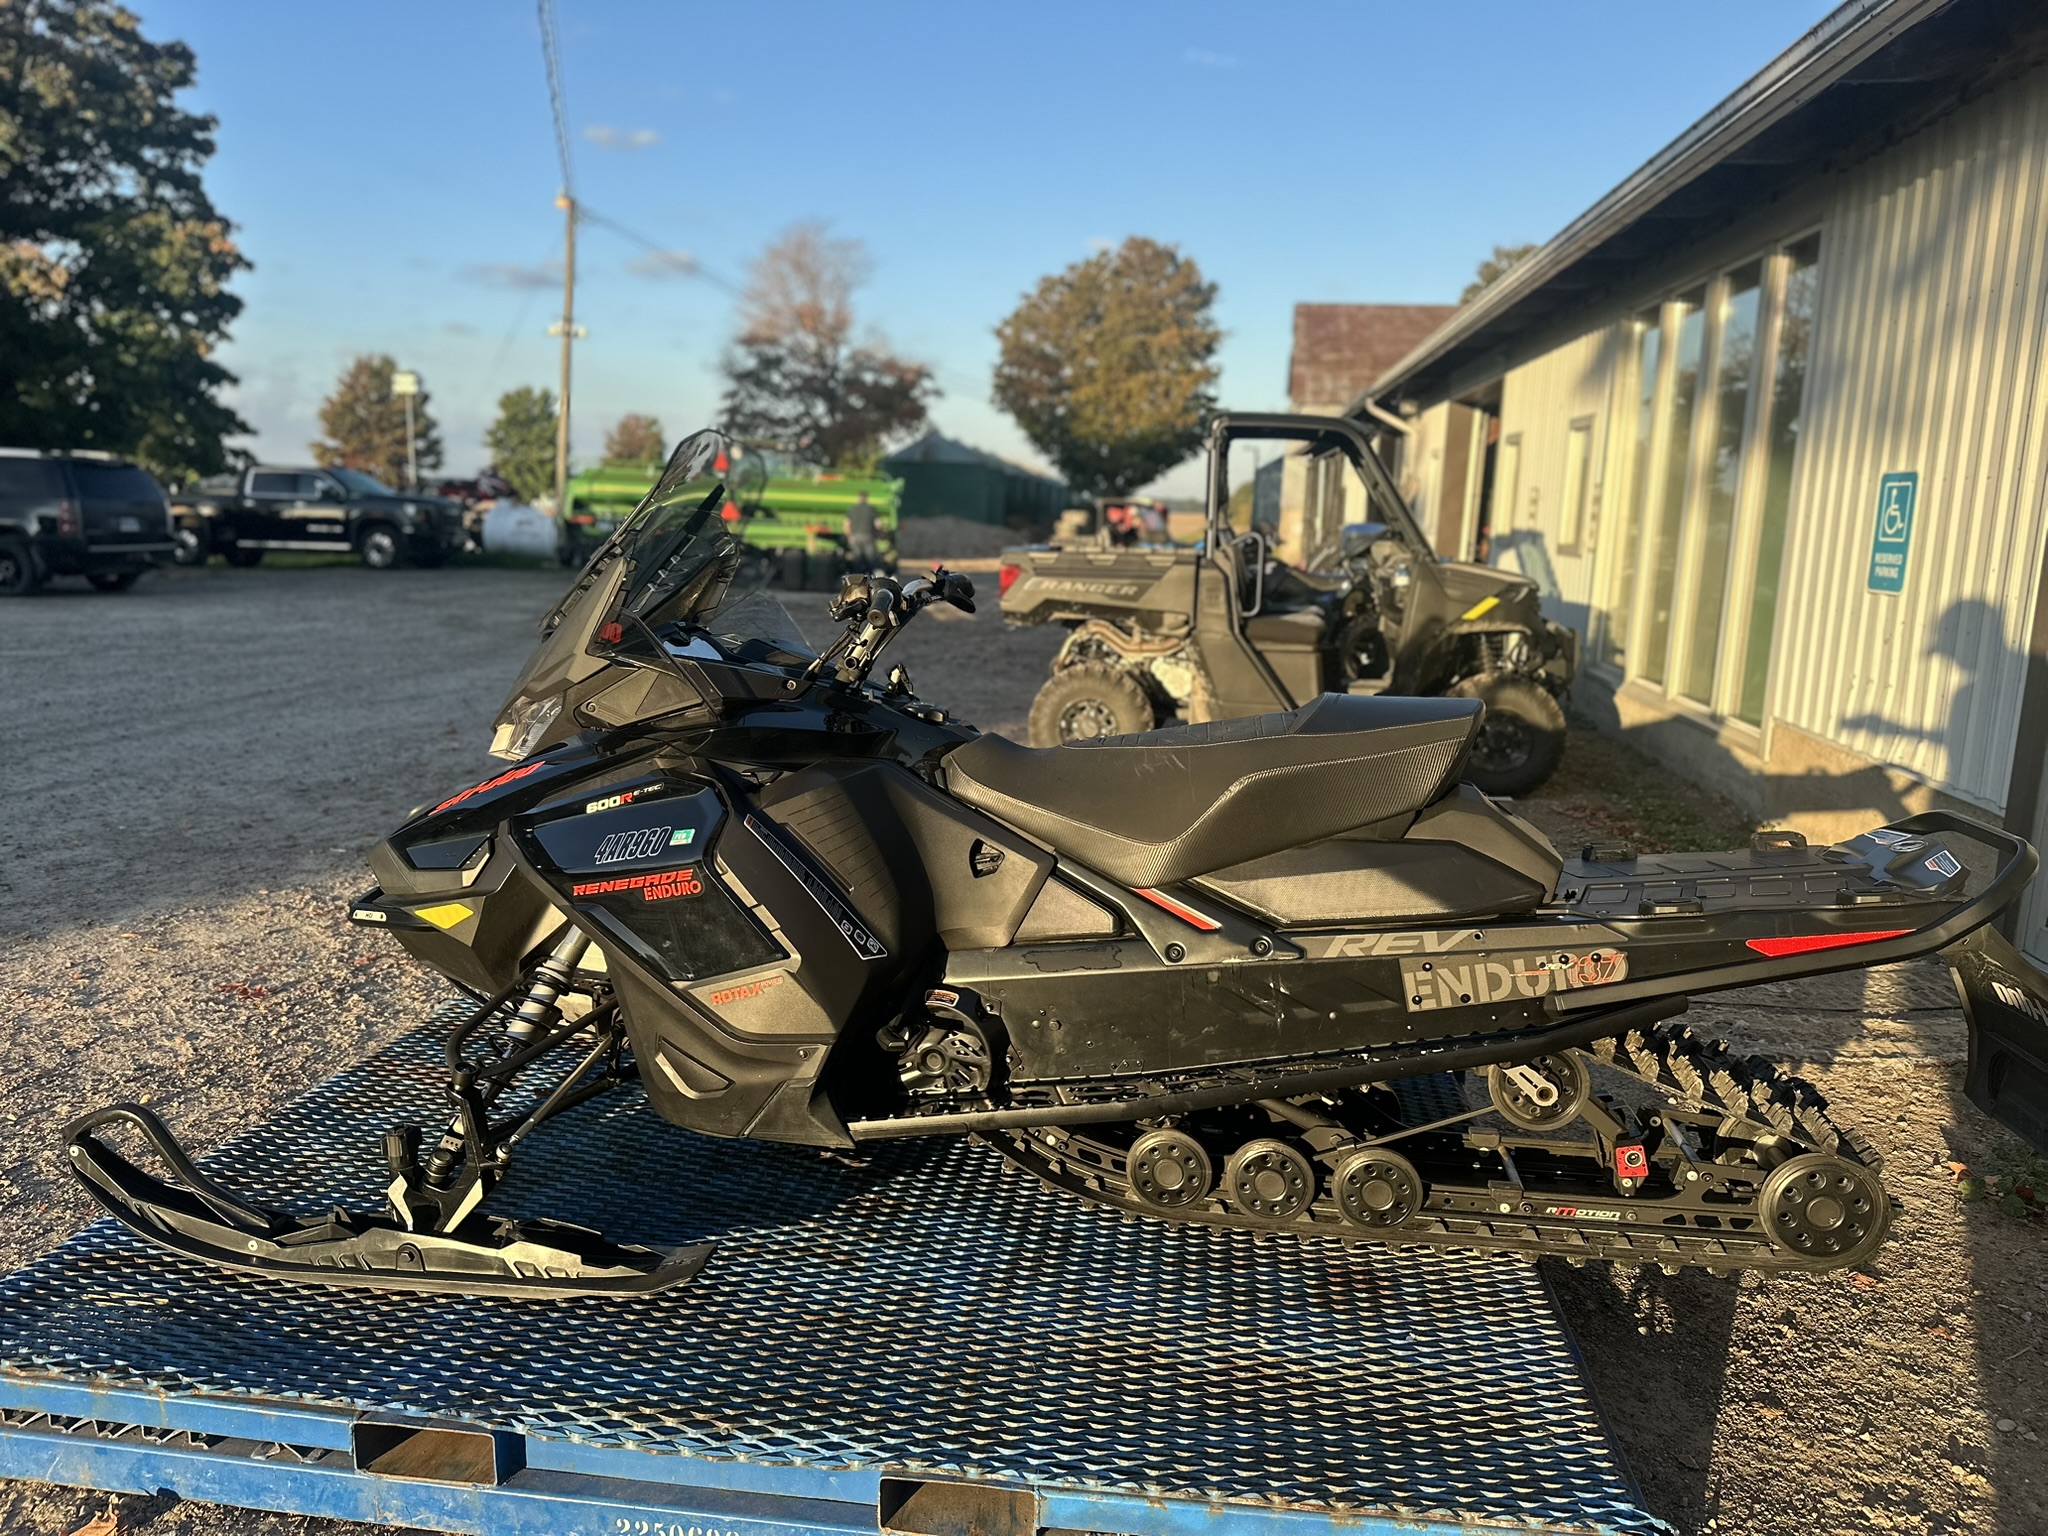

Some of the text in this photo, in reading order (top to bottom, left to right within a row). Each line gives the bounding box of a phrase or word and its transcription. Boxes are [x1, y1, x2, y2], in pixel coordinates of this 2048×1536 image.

[586, 792, 633, 814] 600R
[594, 826, 672, 865] 4AR960
[573, 869, 694, 897] RENEGADE
[643, 880, 702, 901] ENDURO
[1323, 929, 1475, 958] REV
[711, 983, 763, 1005] ROTAX
